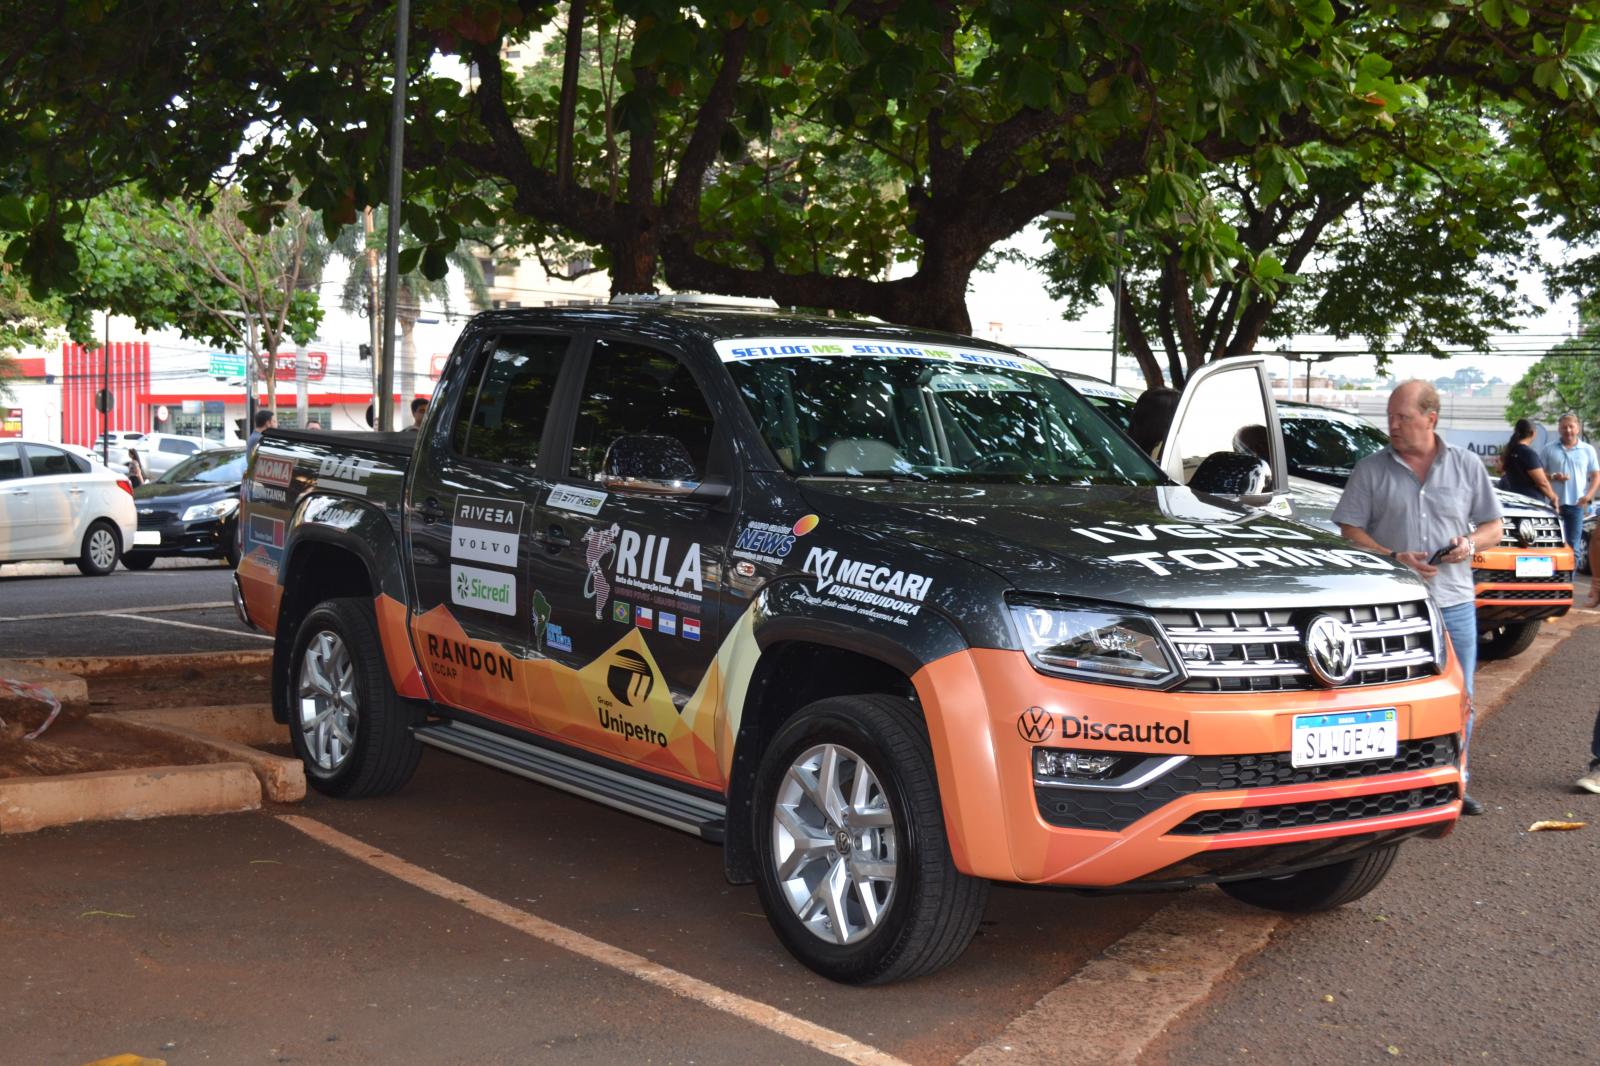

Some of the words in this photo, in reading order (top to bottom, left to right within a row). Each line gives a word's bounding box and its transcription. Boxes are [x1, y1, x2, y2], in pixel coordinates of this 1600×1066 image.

[731, 345, 810, 358] SETLOG
[812, 344, 844, 354] MS
[852, 345, 922, 357] SETLOG
[923, 349, 951, 359] MS
[959, 353, 1022, 369] SETLOG
[1022, 363, 1044, 373] MS
[256, 459, 290, 480] NOMA
[319, 456, 376, 482] DAF
[253, 485, 286, 502] NTANHA
[461, 504, 514, 525] RIVESA
[459, 537, 511, 554] VOLVO
[735, 528, 796, 557] NEWS
[1071, 524, 1314, 544] IVECO
[615, 529, 703, 592] RILA
[1107, 548, 1396, 577] TORINO
[471, 579, 510, 604] Sicredi
[836, 558, 933, 601] MECARI
[828, 584, 921, 616] DISTRIBUIDORA
[428, 634, 514, 682] RANDON
[1178, 643, 1208, 660] V6
[597, 696, 613, 708] Grupo
[598, 707, 668, 748] Unipetro
[1062, 716, 1190, 745] Discautol
